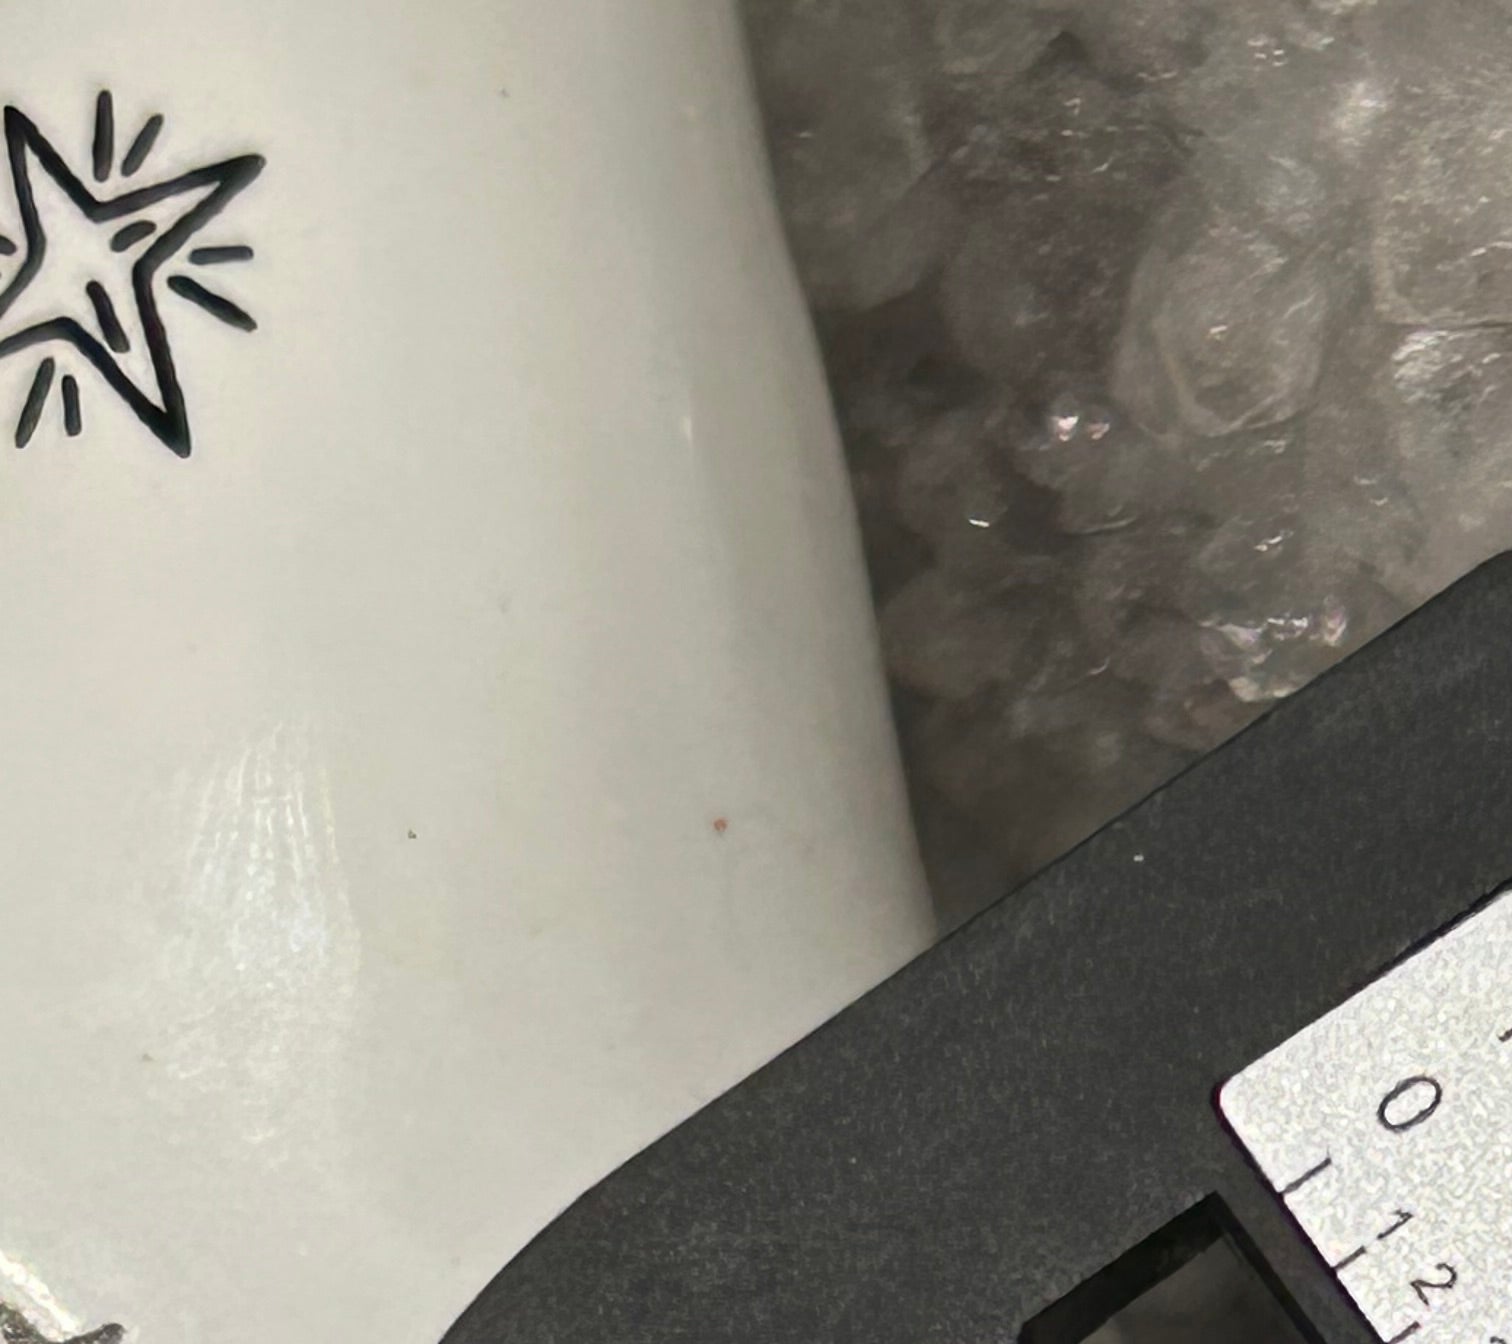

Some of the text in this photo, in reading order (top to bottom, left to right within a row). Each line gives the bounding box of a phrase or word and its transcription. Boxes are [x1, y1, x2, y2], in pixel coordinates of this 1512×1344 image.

[1377, 1074, 1442, 1132] 0
[1376, 1209, 1415, 1240] 1
[1409, 1262, 1459, 1307] 2
